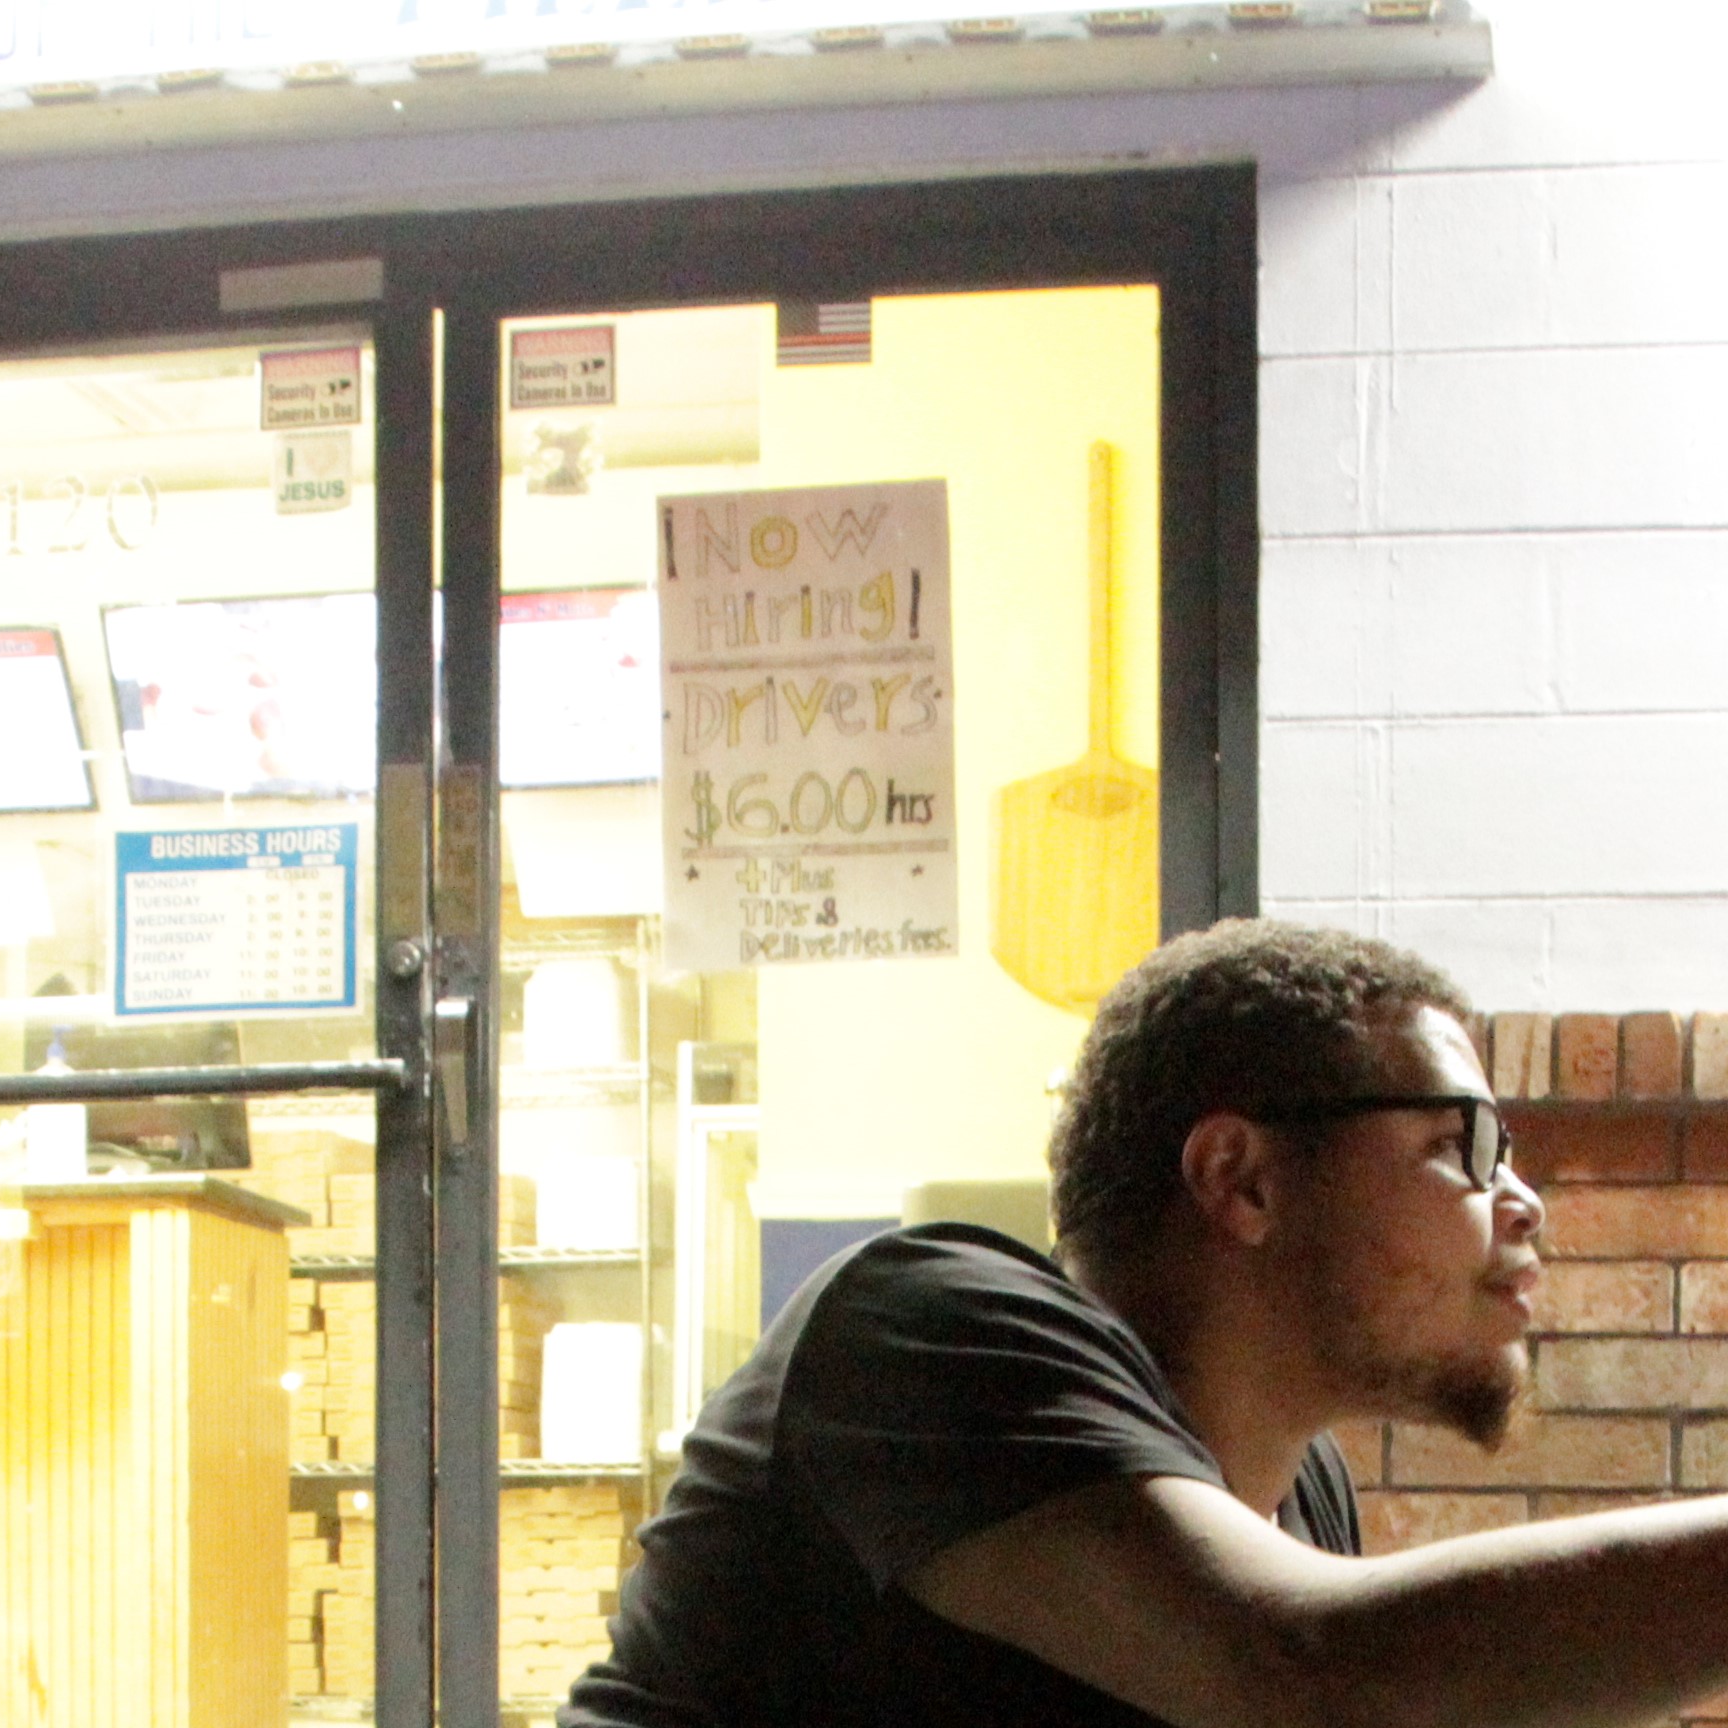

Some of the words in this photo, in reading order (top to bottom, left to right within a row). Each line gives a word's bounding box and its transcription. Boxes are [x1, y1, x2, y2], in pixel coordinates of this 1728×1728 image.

[518, 360, 567, 380] Security
[286, 447, 294, 477] I
[278, 479, 345, 502] JESUS
[684, 767, 877, 848] $6.00
[884, 778, 934, 825] hrs
[150, 831, 260, 859] BUSINESS
[265, 827, 341, 854] HOURS
[133, 876, 197, 889] MONDAY
[135, 895, 201, 908] TUESDAY
[134, 913, 226, 927] WEDNESDAY
[134, 931, 214, 945] THURSDAY
[133, 950, 185, 964] FRIDAY
[133, 968, 210, 983] SATURDAY
[133, 988, 193, 1002] SUNDAY
